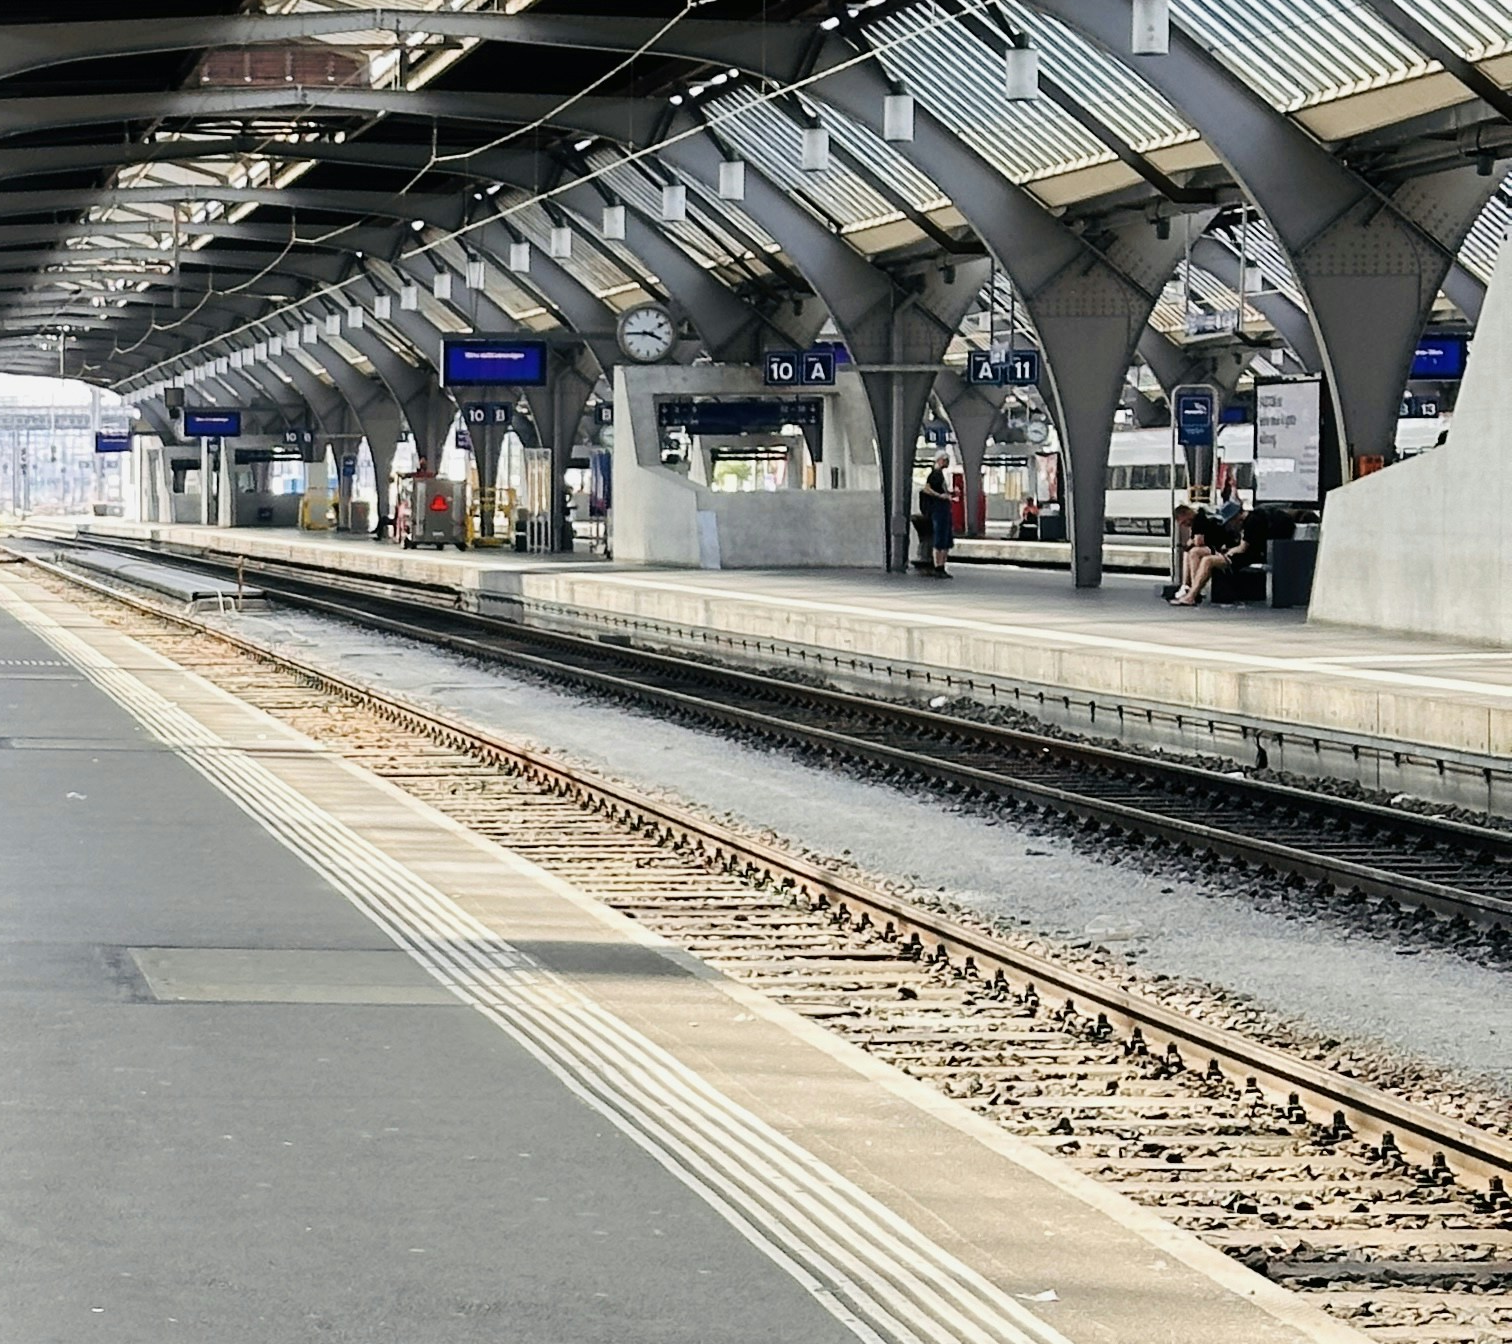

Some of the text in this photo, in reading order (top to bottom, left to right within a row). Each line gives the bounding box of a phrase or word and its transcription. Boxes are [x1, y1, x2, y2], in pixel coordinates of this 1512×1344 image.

[770, 362, 793, 380] 10
[811, 362, 826, 380] A
[978, 361, 993, 379] A
[1014, 361, 1030, 379] 11
[469, 409, 485, 422] 10
[1421, 403, 1436, 416] 13
[285, 432, 297, 442] 10
